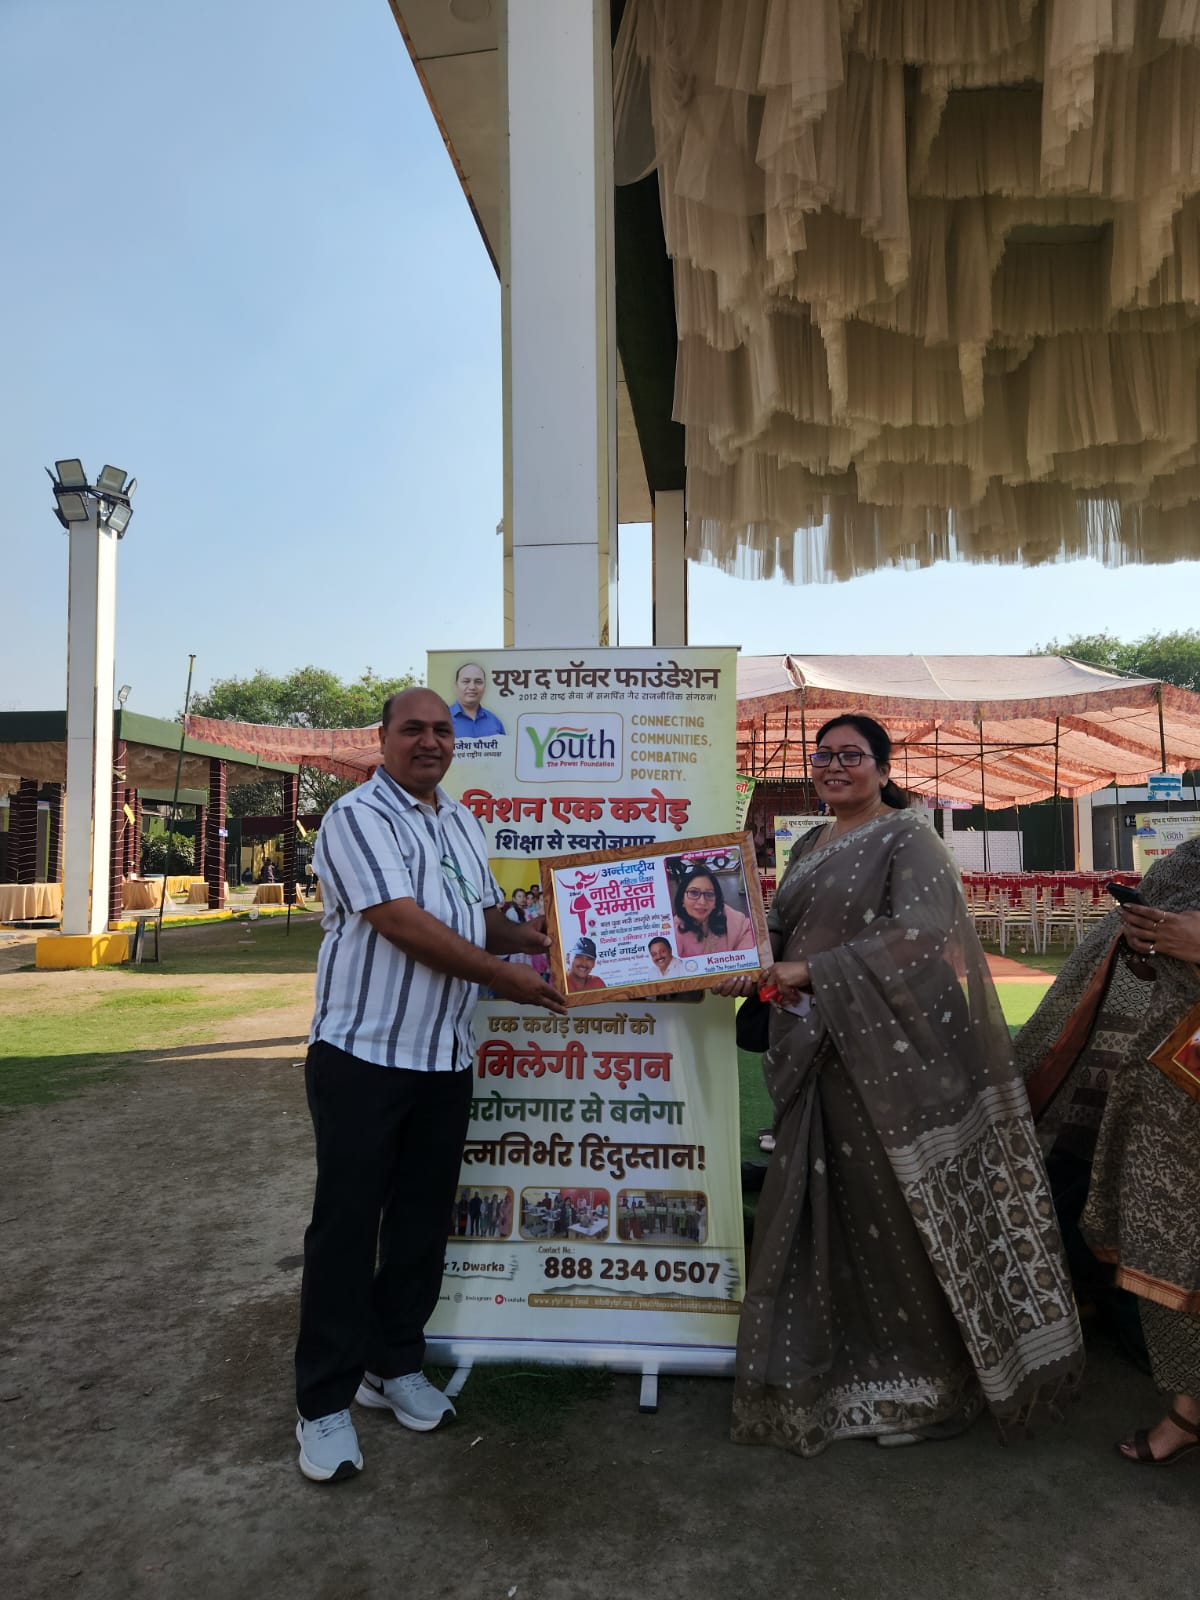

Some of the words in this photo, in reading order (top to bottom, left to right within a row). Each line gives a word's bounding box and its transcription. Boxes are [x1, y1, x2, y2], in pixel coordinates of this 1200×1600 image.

[492, 669, 532, 697] यूथ
[534, 669, 552, 689] द
[555, 661, 611, 688] पॉवर
[614, 660, 721, 688] फाउंडेशन
[518, 693, 538, 701] 2012
[540, 691, 547, 701] से
[568, 691, 583, 700] सेवा
[631, 714, 705, 728] CONNECTING
[526, 726, 615, 768] Youth
[631, 732, 712, 747] COMMUNITIES,
[580, 760, 615, 768] Foundation
[630, 750, 697, 764] COMBATING
[630, 768, 686, 781] POVERTY.
[460, 788, 547, 824] मिशन
[549, 796, 605, 824] एक
[608, 787, 692, 832] करोड़
[495, 829, 544, 853] शिक्षा
[546, 829, 564, 850] से
[589, 880, 620, 900] नारी
[623, 882, 654, 897] रत्न
[594, 895, 655, 916] सम्मान
[707, 954, 746, 965] Kanchan
[488, 1017, 520, 1032] एक
[522, 1012, 570, 1039] करोड़
[573, 1012, 628, 1034] सपनों
[629, 1012, 656, 1035] को
[476, 1039, 588, 1080] मिलेगी
[592, 1051, 673, 1090] उड़ान
[468, 1090, 575, 1122] वरोजगार
[580, 1092, 604, 1123] से
[609, 1093, 685, 1125] बनेगा
[463, 1131, 574, 1167] त्मनिर्भर
[579, 1133, 705, 1180] हिंदुस्तान!
[462, 1261, 505, 1272] Dwarka
[544, 1257, 593, 1279] 888
[600, 1258, 648, 1282] 234
[654, 1260, 721, 1284] 0507
